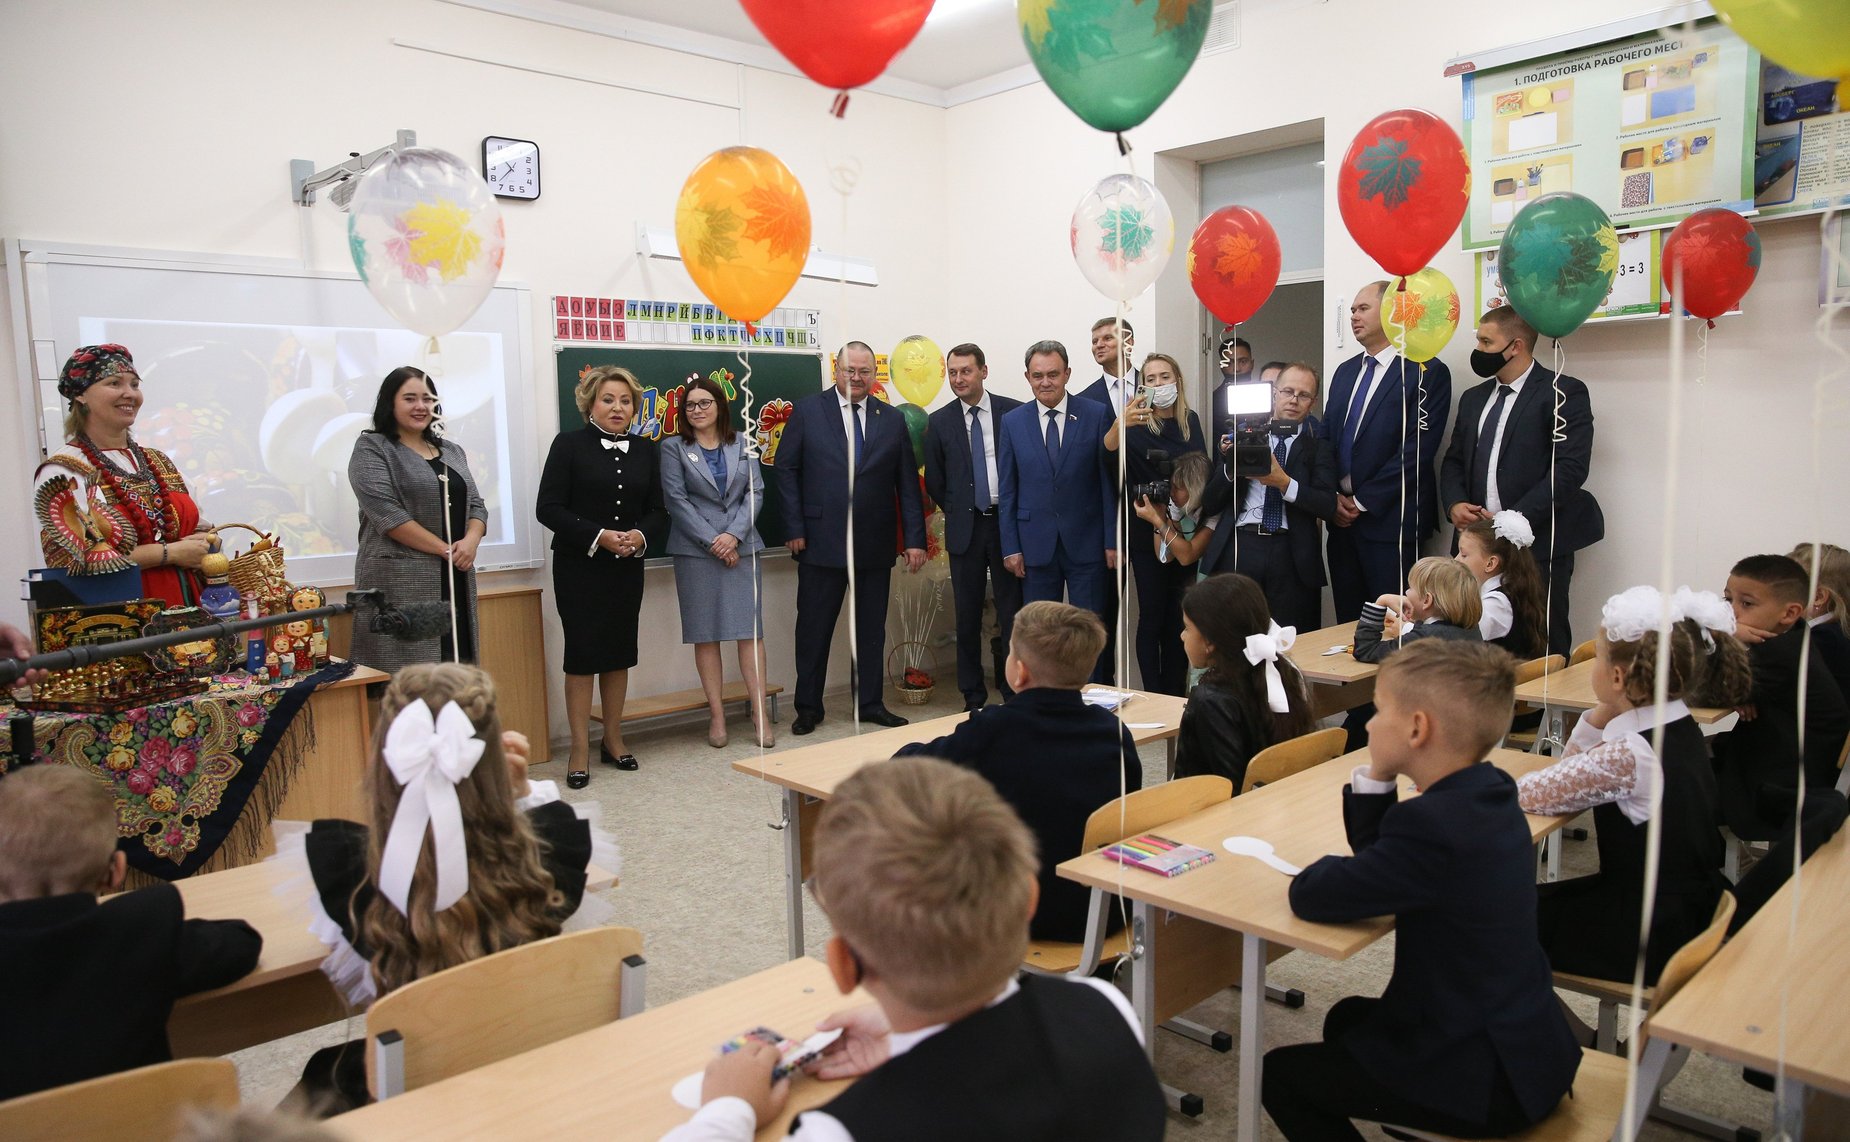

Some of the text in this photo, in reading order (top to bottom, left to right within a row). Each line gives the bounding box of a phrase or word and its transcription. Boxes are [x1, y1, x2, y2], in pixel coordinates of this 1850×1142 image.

[1514, 78, 1521, 86] 1.
[1524, 61, 1592, 84] ПОДГОТОВКА
[1594, 48, 1651, 68] РАБОЧЕГО
[1796, 105, 1815, 114] ОКЕАН
[1620, 264, 1626, 276] 3
[1638, 262, 1644, 274] 3
[558, 300, 567, 313] А
[572, 300, 580, 313] О
[587, 302, 595, 314] У
[599, 302, 611, 315] Ы
[615, 303, 622, 316] Э
[627, 304, 637, 316] Л
[641, 305, 651, 317] М
[654, 306, 663, 318] Н
[667, 306, 675, 318] Р
[680, 304, 689, 318] Й
[692, 308, 700, 319] Б
[706, 308, 713, 320] В
[808, 314, 816, 324] Ъ
[560, 323, 568, 335] Я
[574, 320, 582, 336] Ё
[586, 323, 598, 336] Ю
[602, 324, 610, 336] И
[616, 325, 623, 337] Е
[693, 328, 701, 340] П
[705, 329, 714, 340] Ф
[718, 330, 725, 341] К
[730, 330, 737, 341] Т
[764, 331, 772, 342] Х
[776, 332, 784, 346] Ц
[787, 332, 795, 343] Ч
[797, 332, 807, 344] Щ
[810, 333, 816, 344] Ь
